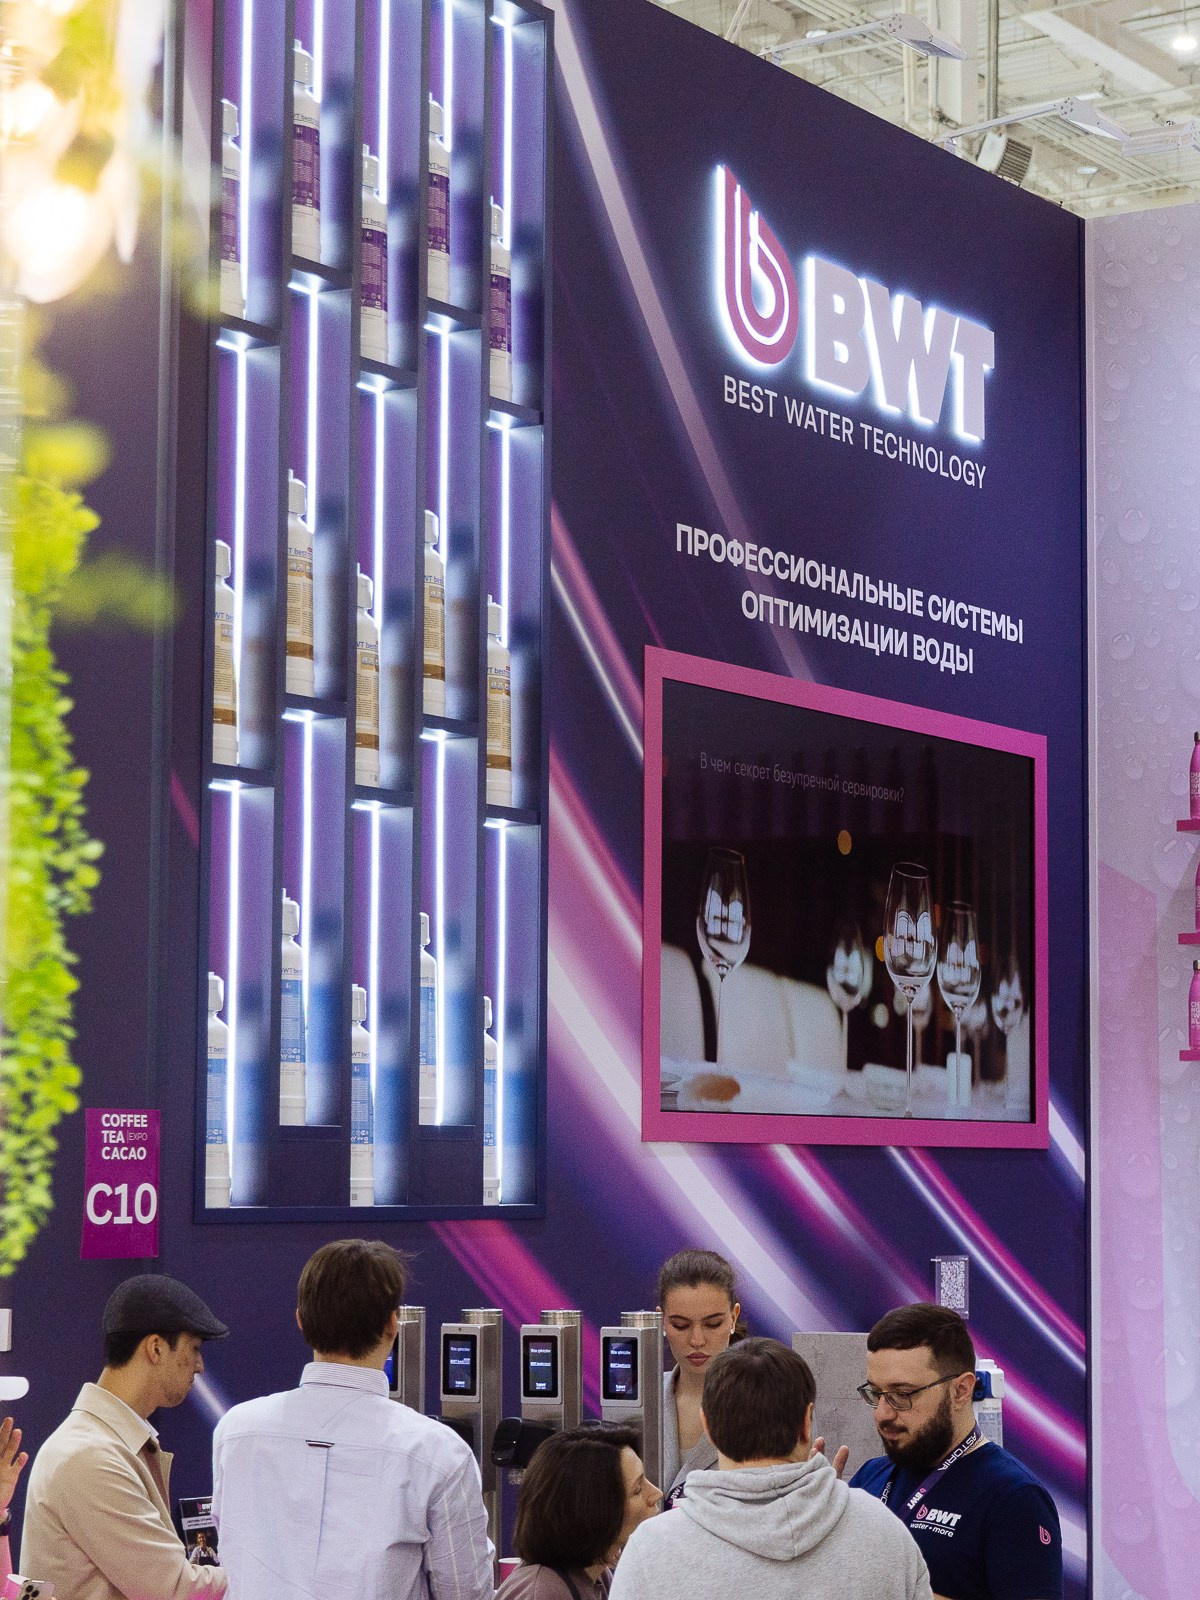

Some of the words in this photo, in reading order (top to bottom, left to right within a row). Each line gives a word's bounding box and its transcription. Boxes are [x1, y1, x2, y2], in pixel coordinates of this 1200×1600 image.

[805, 256, 995, 442] BWT
[723, 374, 777, 418] BEST
[783, 395, 854, 445] WATER
[859, 422, 987, 489] TECHNOLOGY
[676, 522, 925, 618] ПРОФЕССИОНАЛЬНЫЕ
[927, 594, 1024, 644] СИСТЕМЫ
[741, 590, 908, 658] ОПТИМИЗАЦИИ
[913, 633, 974, 675] ВОДЫ
[700, 752, 708, 769] В
[710, 758, 731, 774] чем
[734, 763, 770, 783] секрет
[773, 763, 840, 791] безупречной
[842, 779, 905, 803] сервировки?
[101, 1113, 148, 1128] COFFEE
[101, 1130, 125, 1144] TEA
[129, 1132, 148, 1141] EXPO
[101, 1146, 147, 1161] CACAO
[86, 1182, 158, 1226] C10
[937, 1431, 978, 1471] ASTORIA
[906, 1491, 924, 1510] BWT
[925, 1508, 962, 1527] BWT
